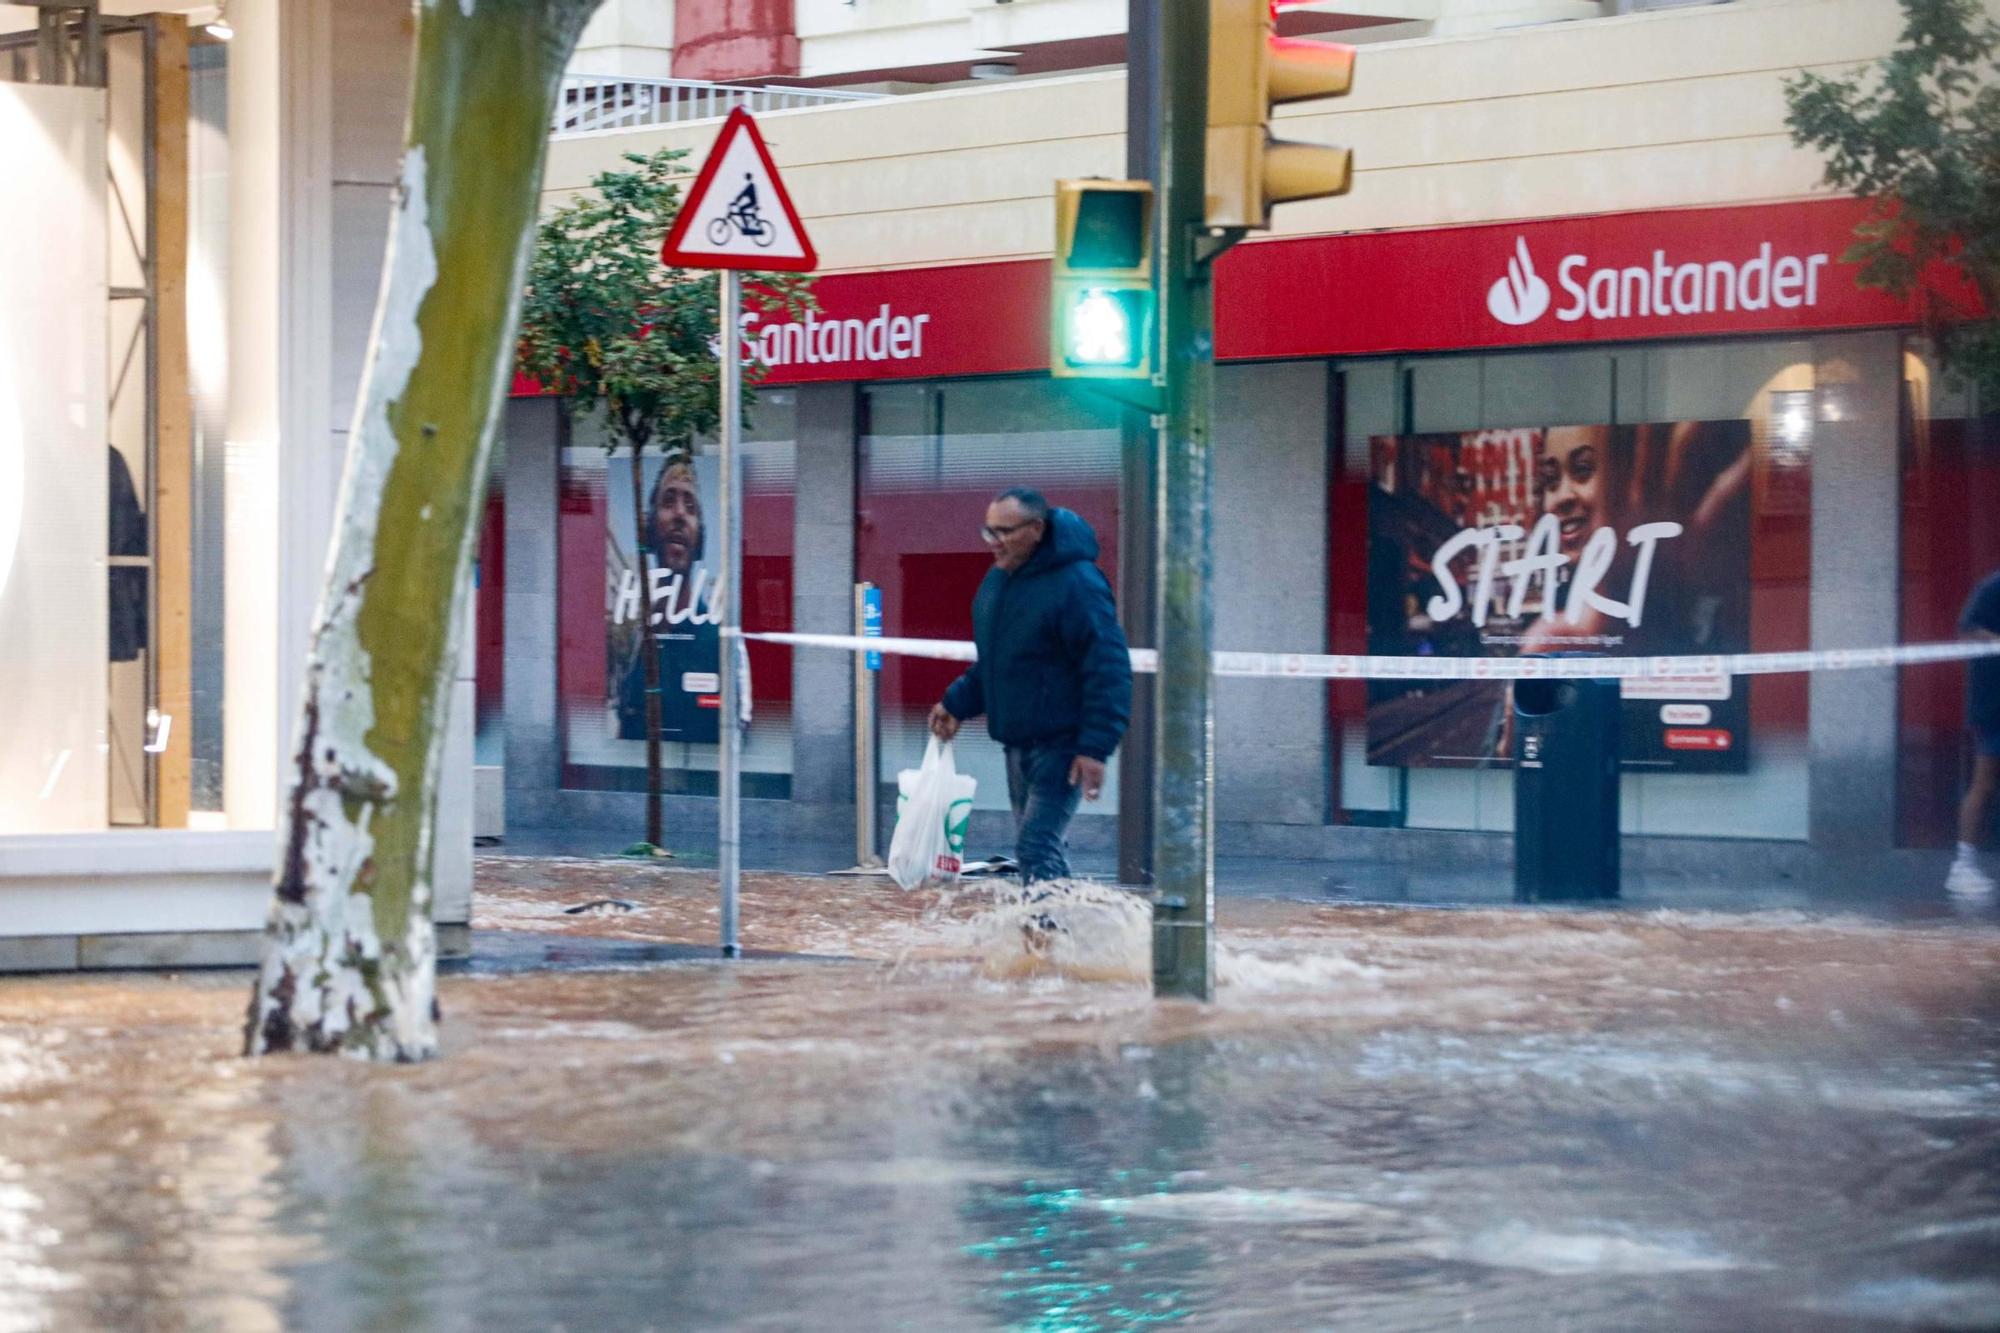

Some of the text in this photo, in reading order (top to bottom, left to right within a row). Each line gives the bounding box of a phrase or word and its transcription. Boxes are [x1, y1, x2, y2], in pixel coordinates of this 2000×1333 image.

[1556, 242, 1828, 321] Santander
[738, 305, 929, 366] Santander
[1427, 513, 1683, 628] START
